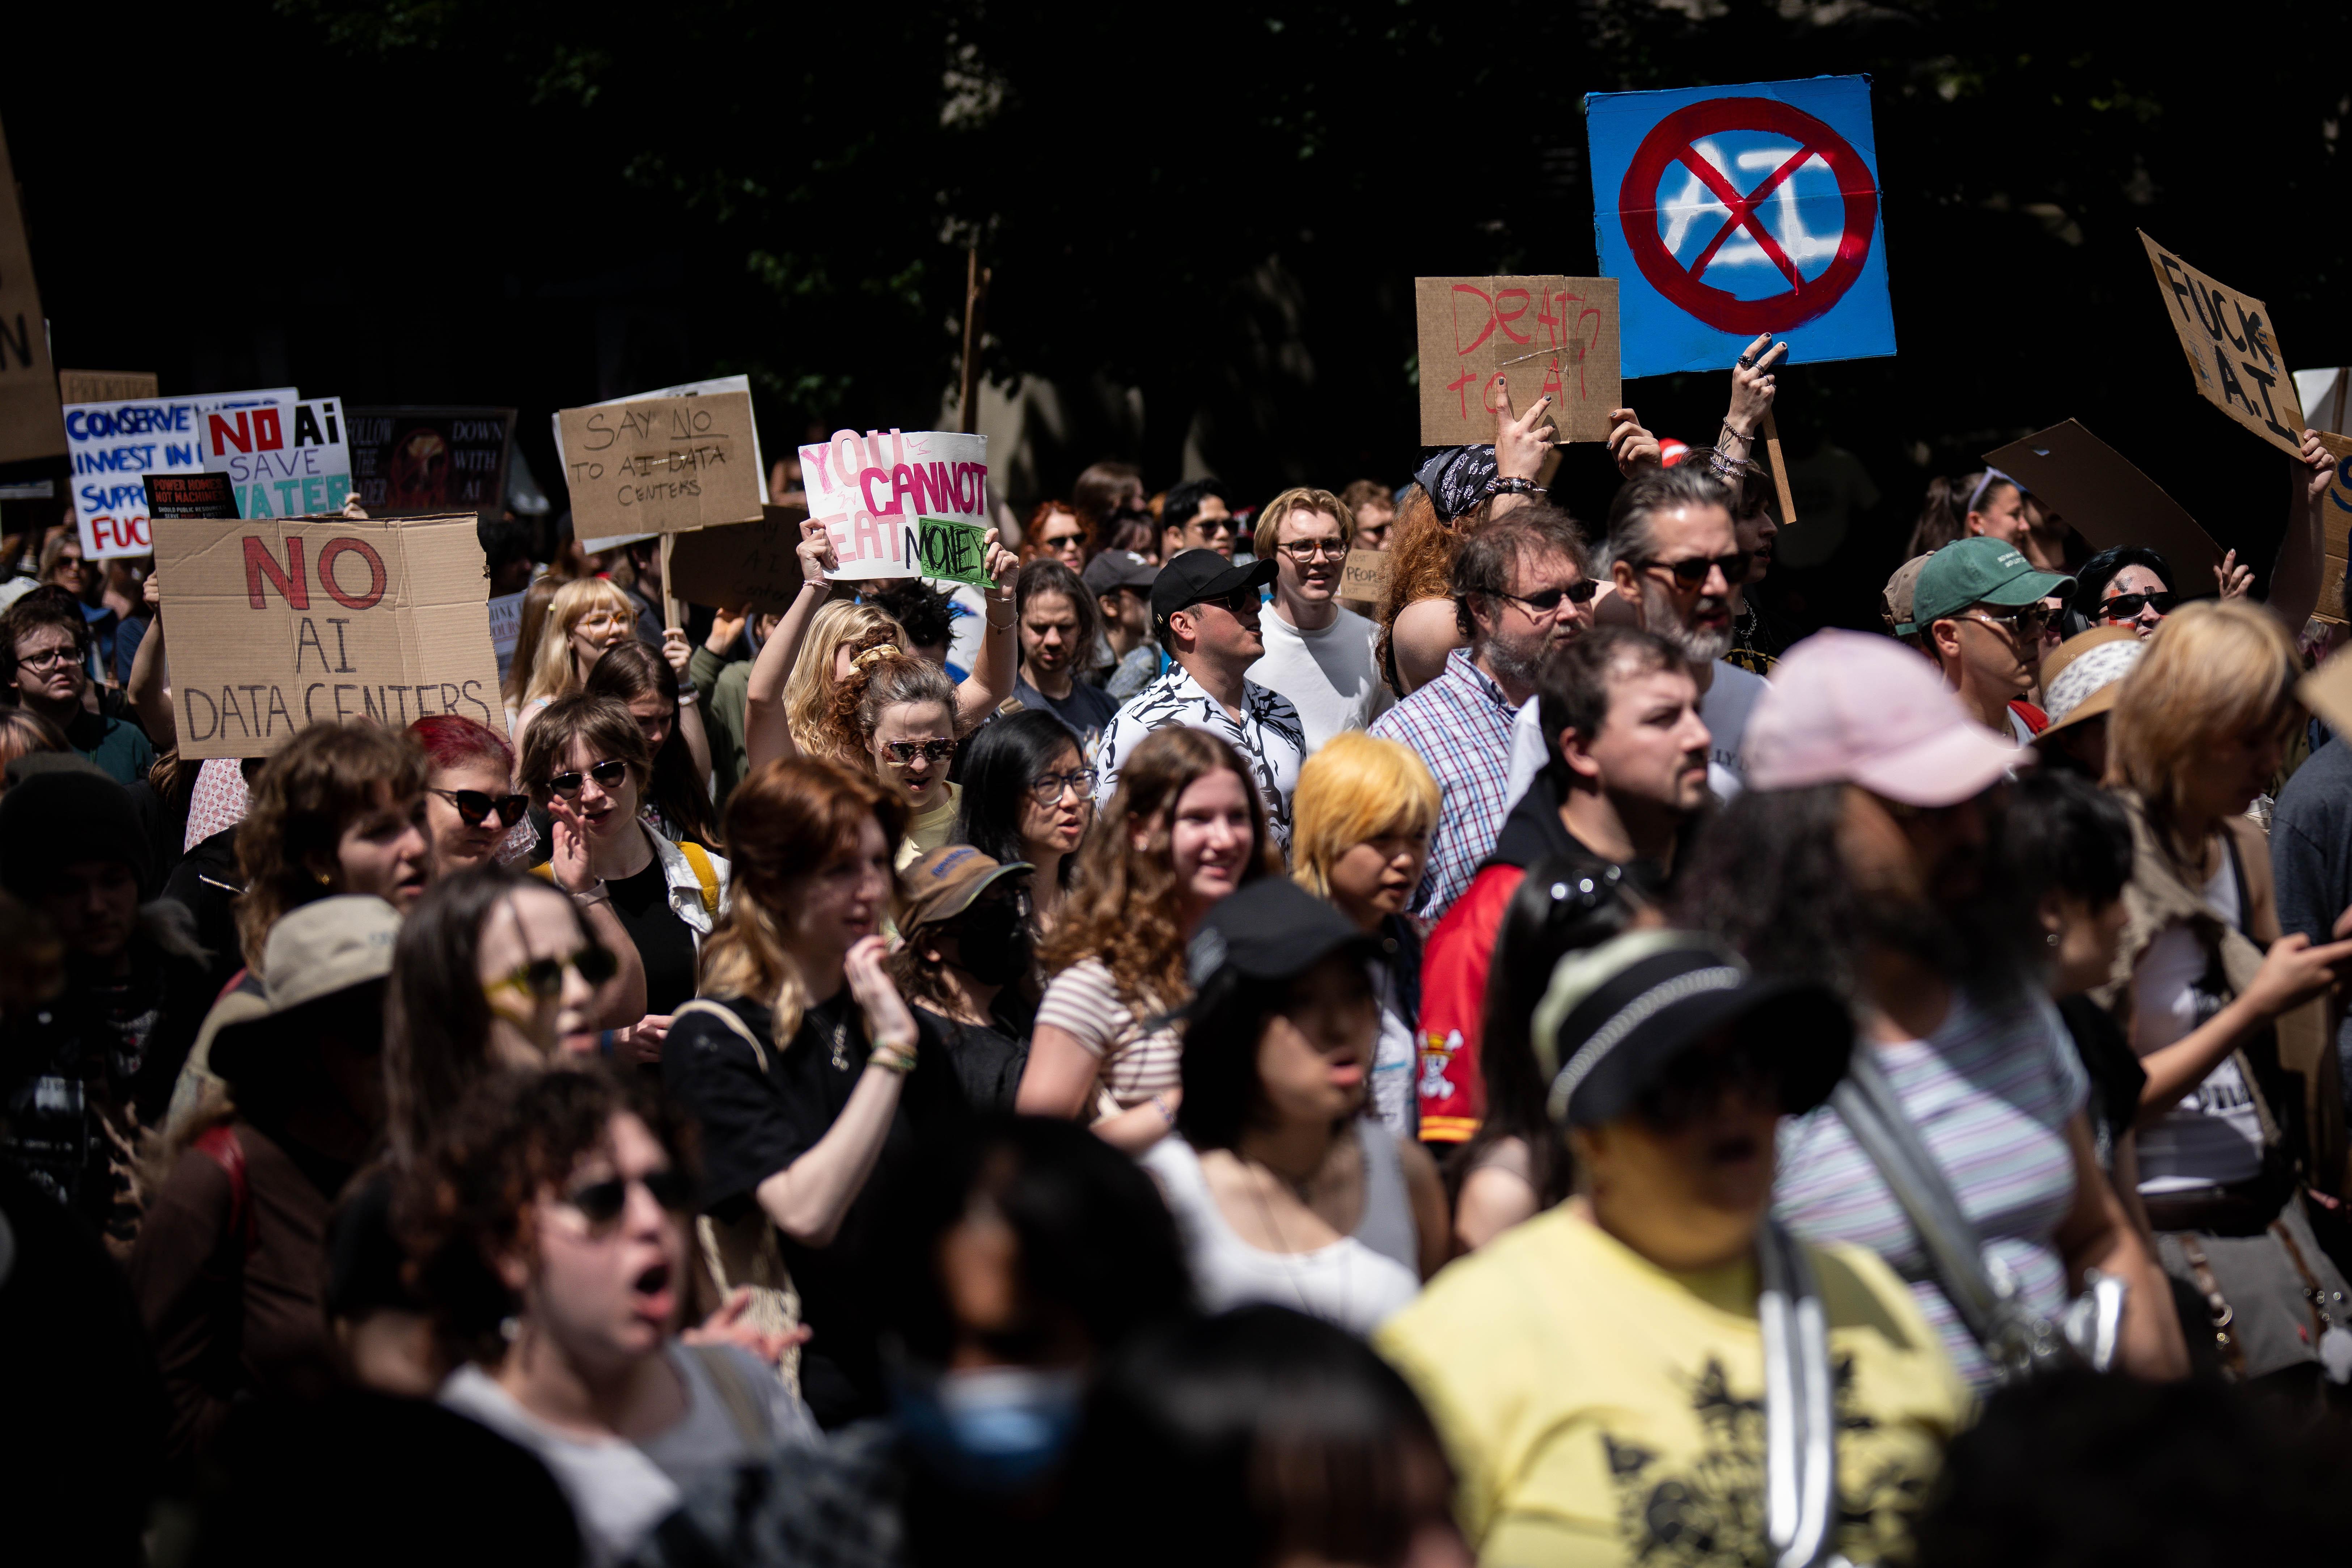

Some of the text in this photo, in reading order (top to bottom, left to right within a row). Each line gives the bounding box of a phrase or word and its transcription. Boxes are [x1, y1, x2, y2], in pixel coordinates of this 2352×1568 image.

[1664, 140, 1845, 266] AI
[2158, 252, 2275, 367] FUCK
[66, 403, 190, 441] CONSERVE
[208, 407, 284, 456] NO
[584, 407, 712, 451] SAY NO
[76, 445, 156, 474] INVEST
[166, 443, 191, 466] IN
[230, 448, 321, 482] SAVE
[571, 445, 726, 483] TO AI DATA
[800, 428, 904, 494] YOU
[153, 478, 224, 491] POWER HOMES
[155, 490, 226, 503] NOT MACHINES
[353, 478, 388, 507] ADER
[618, 479, 702, 506] CENTERS
[859, 461, 987, 518] CANNOT
[819, 510, 906, 563] EAT
[905, 525, 986, 579] MONEY
[242, 536, 387, 610] NO
[1347, 566, 1376, 582] PEOP
[297, 617, 357, 674] AI
[184, 680, 491, 742] DATA CENTERS
